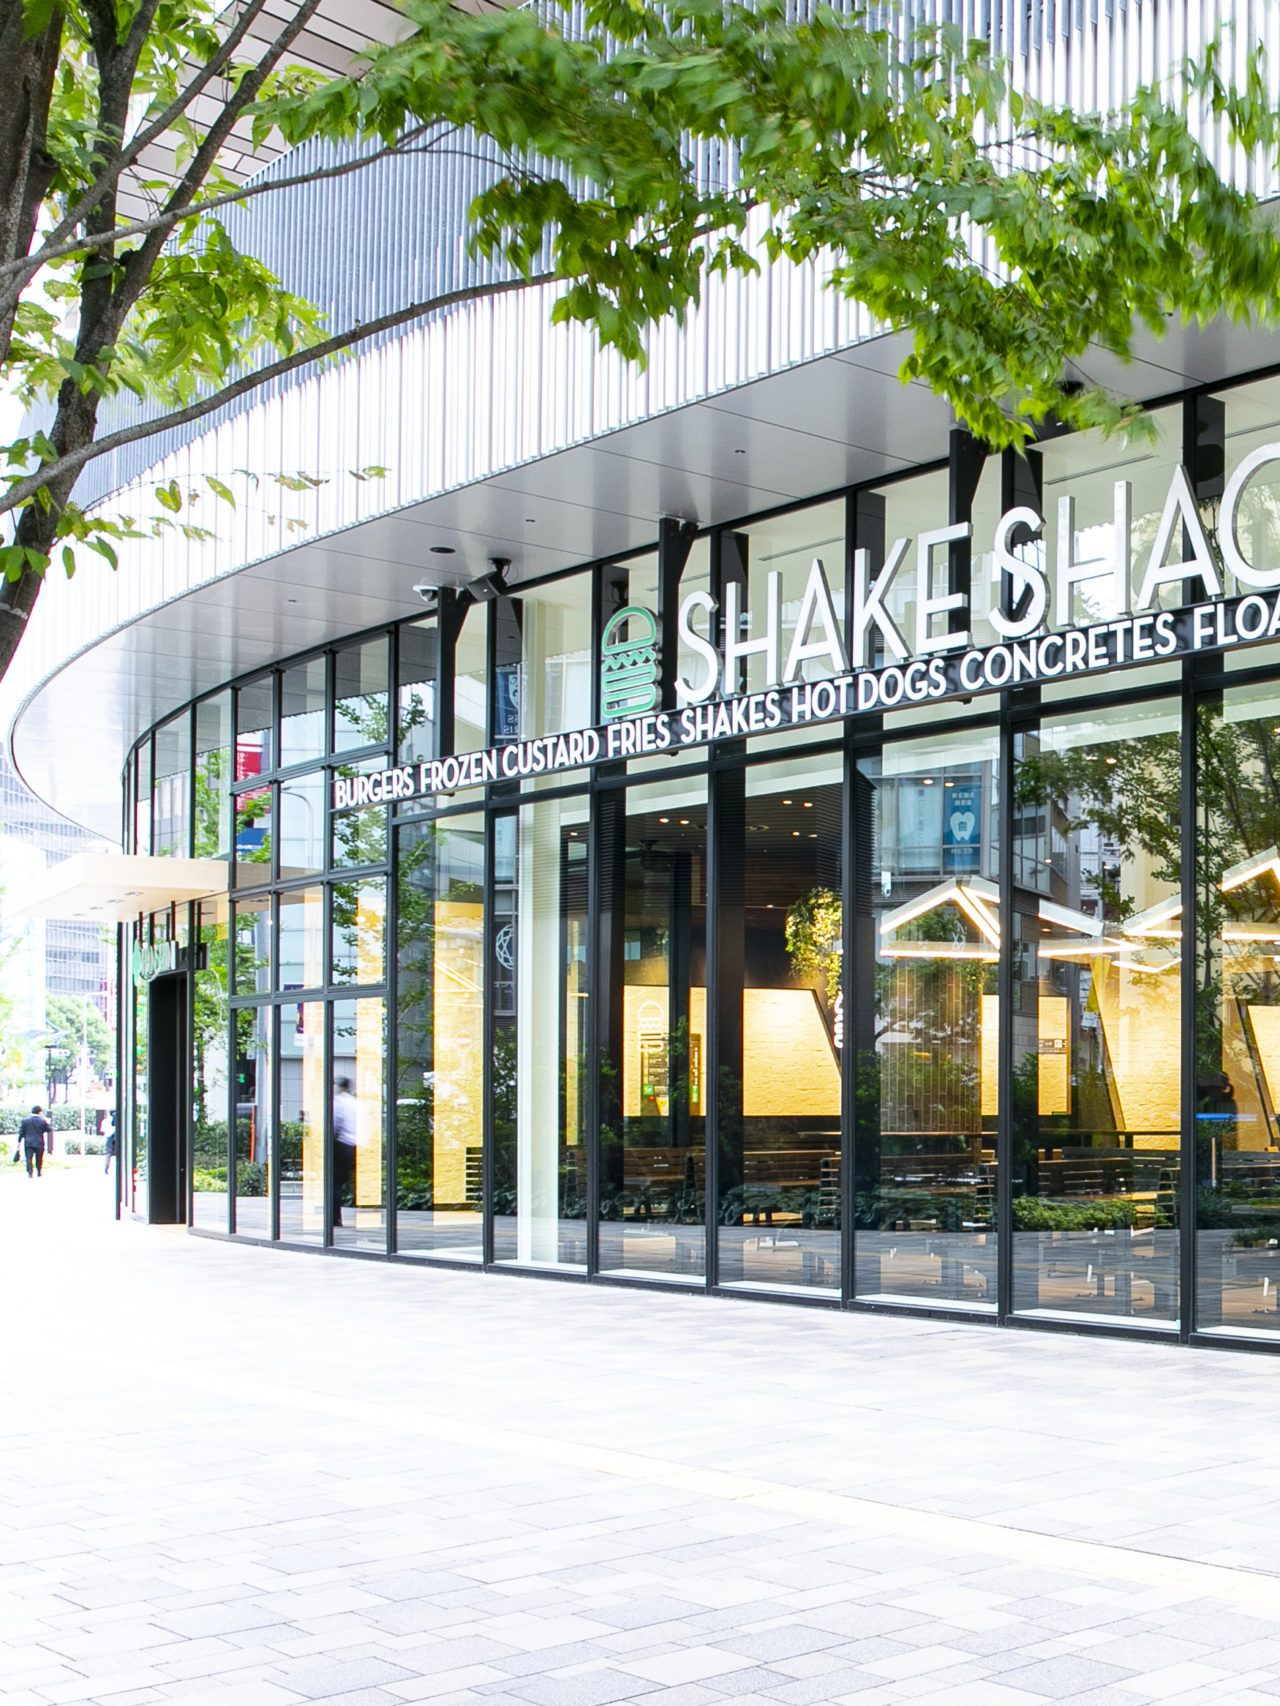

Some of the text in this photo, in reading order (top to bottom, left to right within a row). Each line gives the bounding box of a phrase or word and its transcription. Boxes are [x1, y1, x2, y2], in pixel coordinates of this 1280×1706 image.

[674, 521, 973, 702] SHAKE
[334, 766, 415, 809] BURGERS
[420, 748, 497, 792] FROZEN
[502, 730, 599, 777] CUSTARD
[606, 713, 671, 757] FRIES
[680, 692, 781, 743] SHAKES
[792, 676, 853, 723] HOT
[858, 658, 947, 711] DOGS
[960, 613, 1177, 690] CONCRETES
